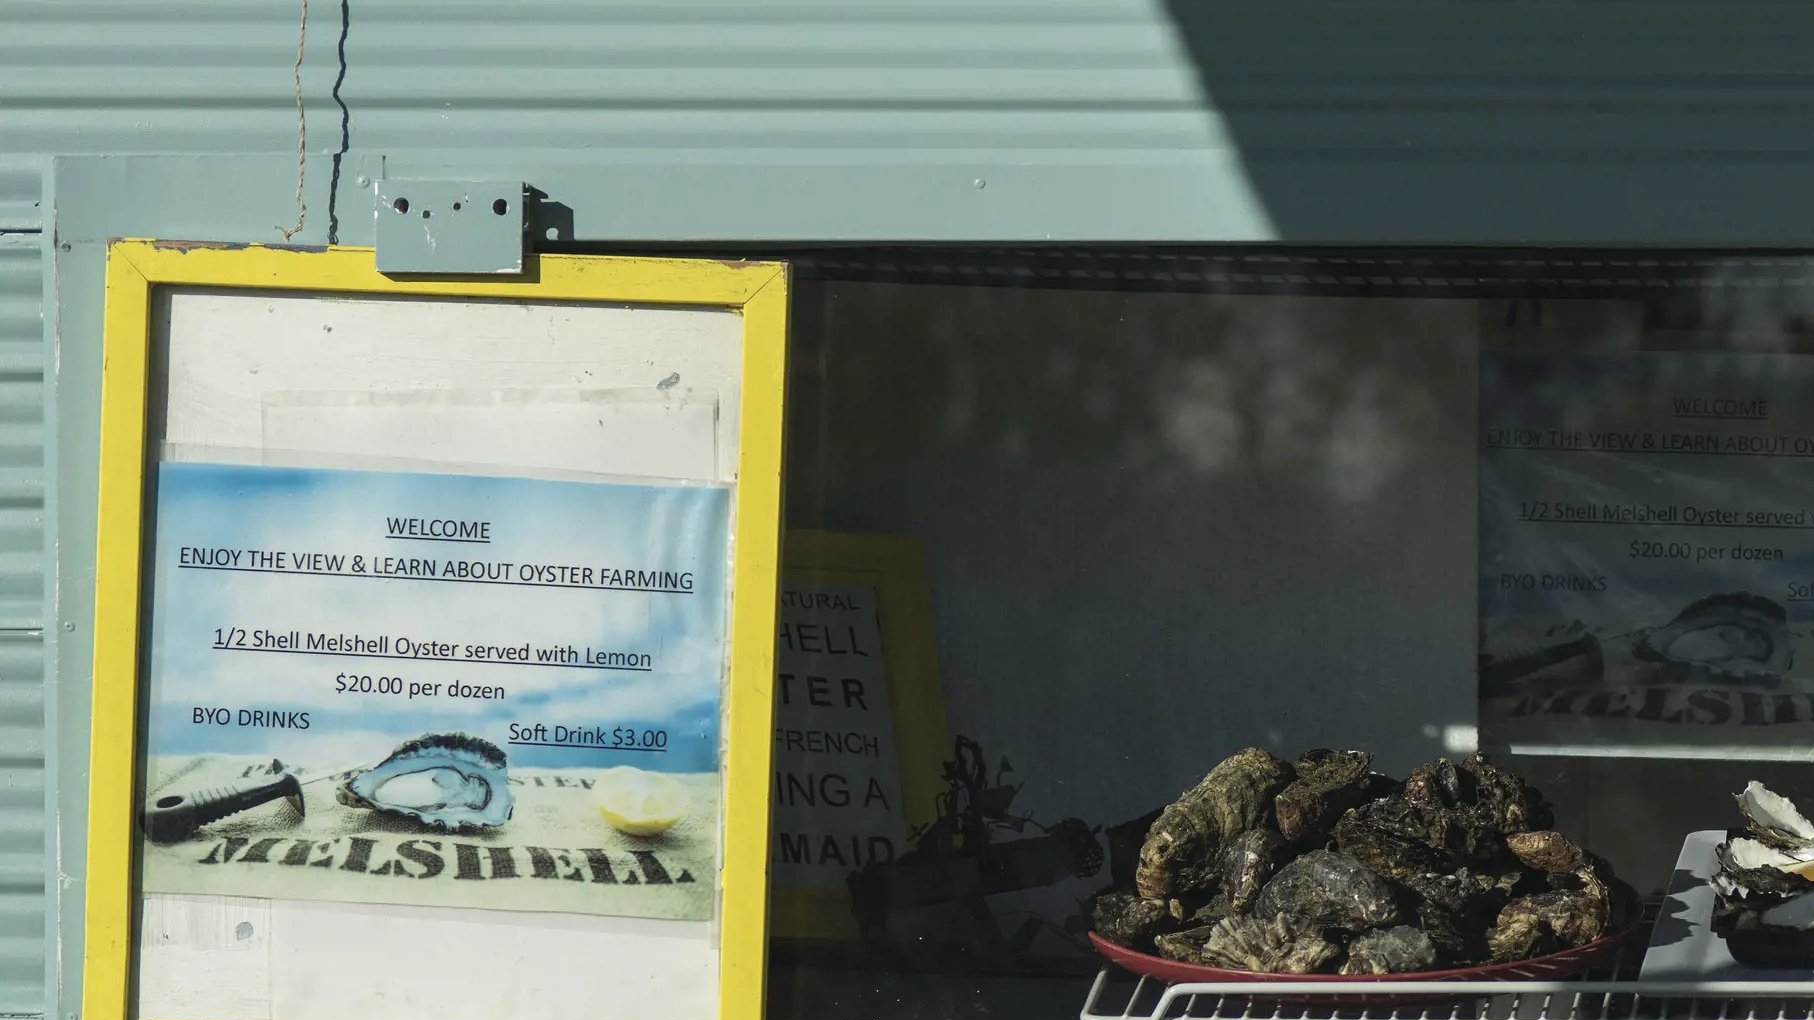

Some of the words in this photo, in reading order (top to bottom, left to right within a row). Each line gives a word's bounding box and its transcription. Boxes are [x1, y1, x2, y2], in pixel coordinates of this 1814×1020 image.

[1672, 397, 1768, 417] WELCOME
[1487, 429, 1542, 447] ENJOY
[1549, 431, 1582, 448] THE
[1588, 432, 1636, 449] VIEW
[1642, 433, 1656, 450] &
[1662, 434, 1719, 451] LEARN
[1724, 436, 1789, 453] ABOUT
[1519, 500, 1548, 520] 1/2
[1554, 502, 1597, 520] Shell
[1603, 504, 1678, 522] Melshell
[1683, 506, 1739, 527] Oyster
[1745, 508, 1805, 526] served
[387, 517, 491, 541] WELCOME
[1630, 540, 1691, 560] $20.00
[1696, 546, 1725, 563] per
[1730, 543, 1783, 562] dozen
[180, 547, 242, 567] ENJOY
[248, 550, 286, 570] THE
[292, 552, 346, 573] VIEW
[351, 554, 367, 574] &
[373, 556, 436, 577] LEARN
[443, 560, 514, 581] ABOUT
[519, 564, 594, 585] OYSTER
[600, 568, 694, 590] FARMING
[1501, 573, 1535, 590] BYO
[1541, 574, 1608, 593] DRINKS
[781, 590, 861, 611] TURAL
[214, 627, 246, 649] 1/2
[252, 629, 299, 650] Shell
[306, 633, 388, 654] Melshell
[395, 637, 460, 659] Oyster
[464, 643, 530, 661] served
[536, 645, 578, 663] with
[586, 647, 652, 667] Lemon
[779, 622, 870, 657] HELL
[335, 672, 403, 695] $20.00
[408, 681, 442, 699] per
[447, 679, 505, 700] dozen
[778, 673, 868, 711] TER
[192, 707, 231, 726] BYO
[238, 709, 310, 730] DRINKS
[508, 723, 548, 742] Soft
[554, 725, 606, 745] Drink
[612, 726, 668, 749] $3.00
[776, 771, 850, 808] ING
[862, 776, 890, 811] A
[198, 835, 695, 885] MELSHELL
[780, 832, 895, 867] MAID
